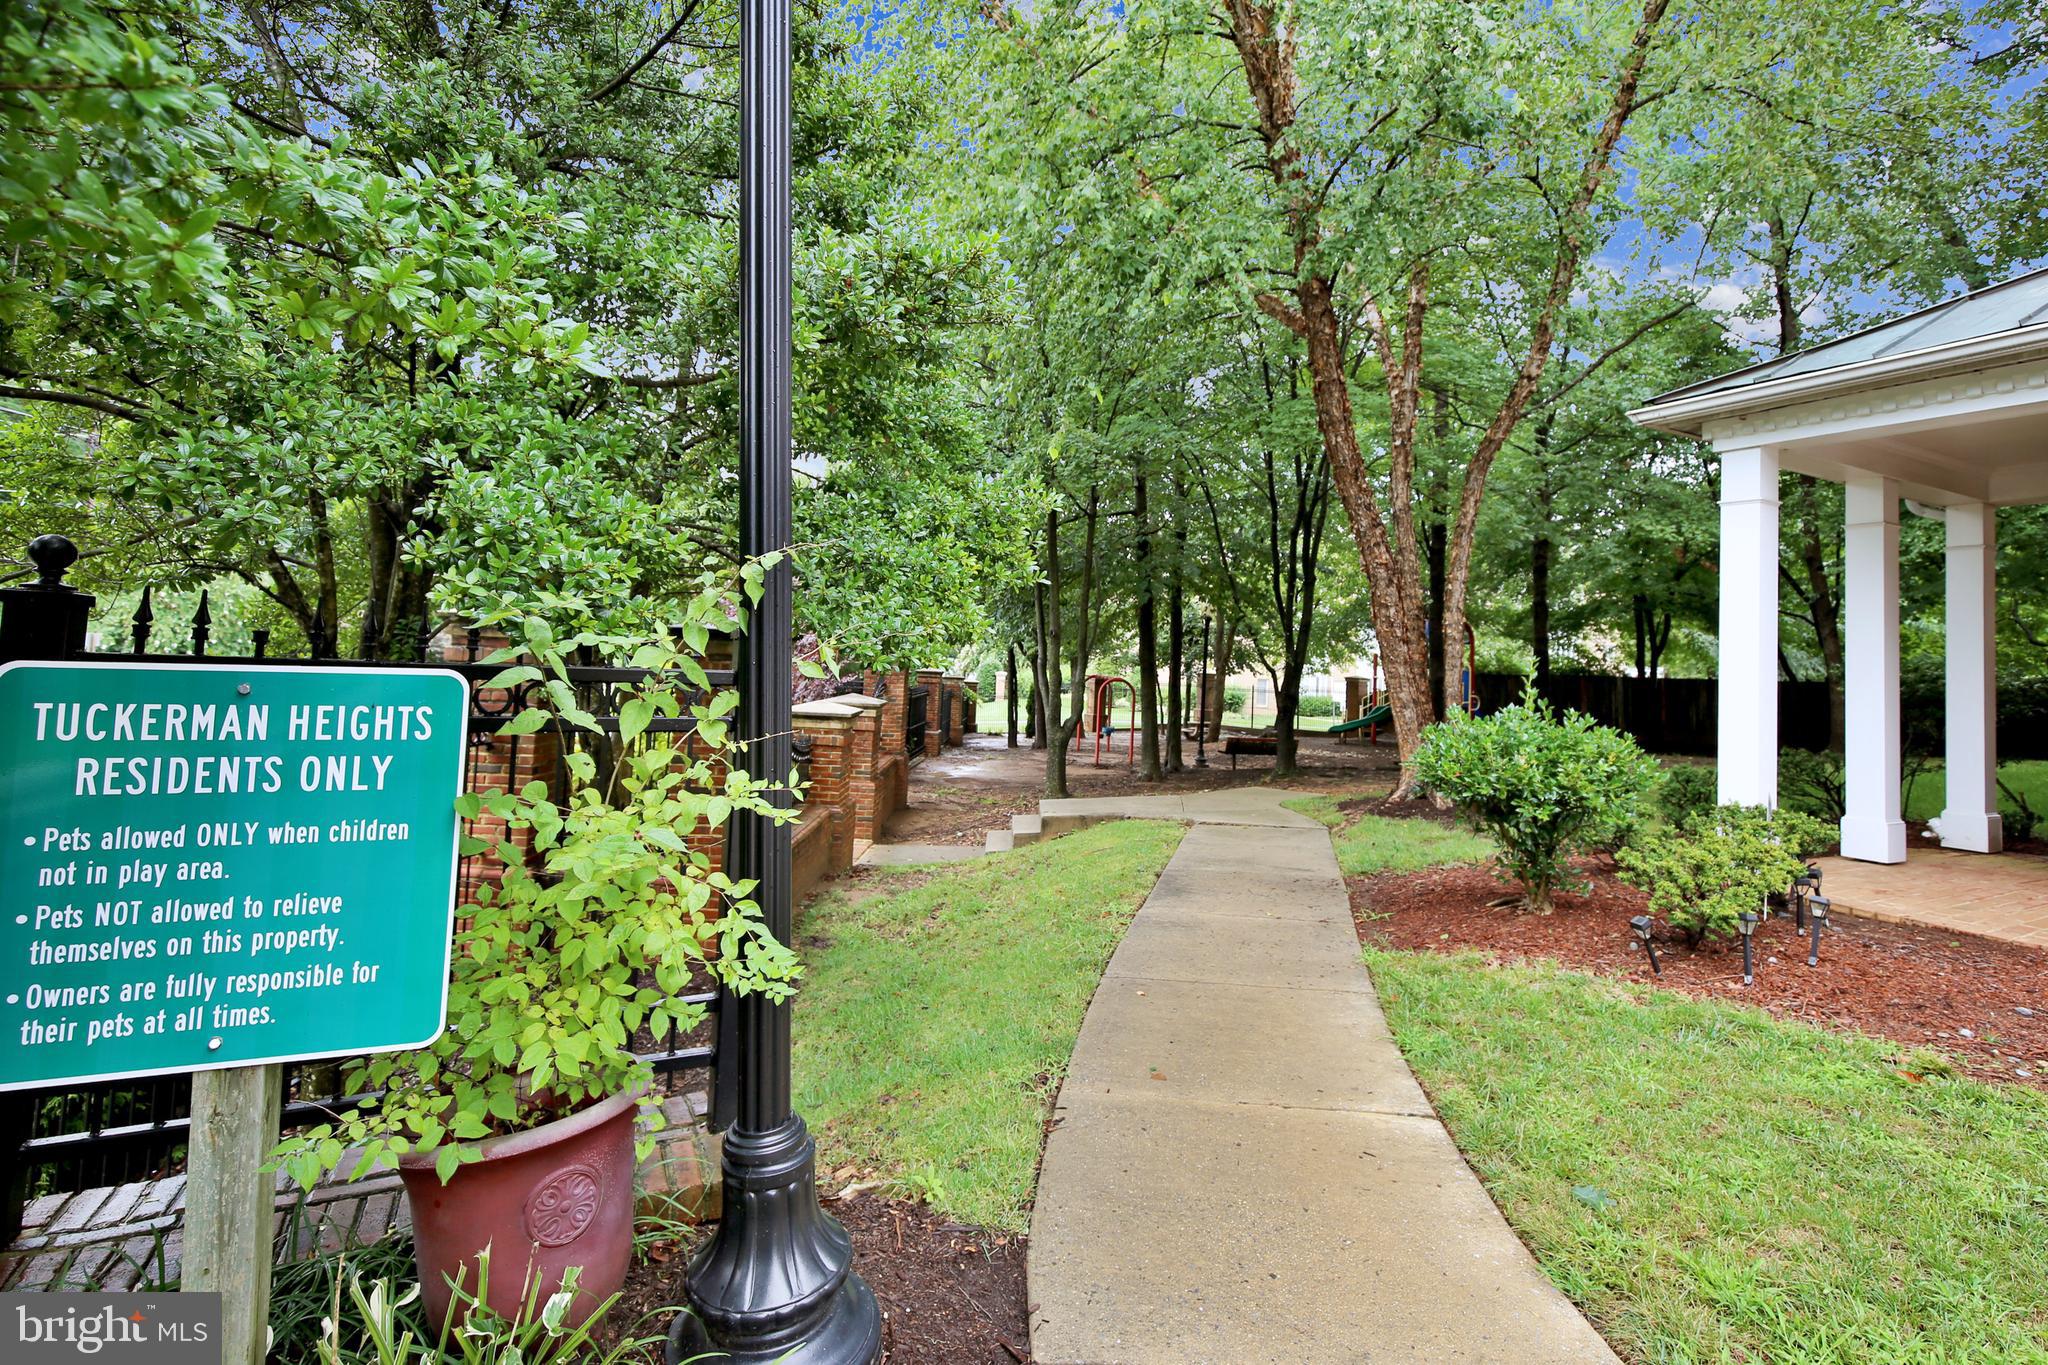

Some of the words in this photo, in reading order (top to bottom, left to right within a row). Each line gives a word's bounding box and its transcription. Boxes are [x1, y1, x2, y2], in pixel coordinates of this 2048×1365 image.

[33, 703, 269, 741] TUCKERMAN
[288, 705, 433, 741] HEIGHTS
[75, 756, 283, 795] RESIDENTS
[300, 755, 394, 792] ONLY
[43, 827, 91, 852] Pets
[100, 823, 186, 850] allowed
[197, 822, 259, 847] ONLY
[268, 821, 320, 845] when
[329, 819, 409, 843] children
[38, 861, 77, 887] not
[86, 860, 108, 885] in
[118, 859, 168, 890] play
[176, 861, 230, 881] area.
[35, 905, 83, 930] Pets
[95, 900, 143, 927] NOT
[151, 896, 234, 924] allowed
[243, 895, 263, 919] to
[273, 892, 343, 917] relieve
[29, 935, 157, 966] themselves
[166, 937, 192, 956] on
[202, 928, 242, 954] this
[251, 924, 344, 957] property.
[26, 979, 110, 1010] Owners
[119, 981, 156, 1003] are
[166, 973, 217, 1002] fully
[226, 963, 344, 994] responsible
[352, 960, 380, 984] for
[20, 1017, 78, 1046] their
[87, 1013, 134, 1046] pets
[143, 1009, 167, 1035] at
[174, 1006, 204, 1032] all
[212, 1003, 276, 1029] times.
